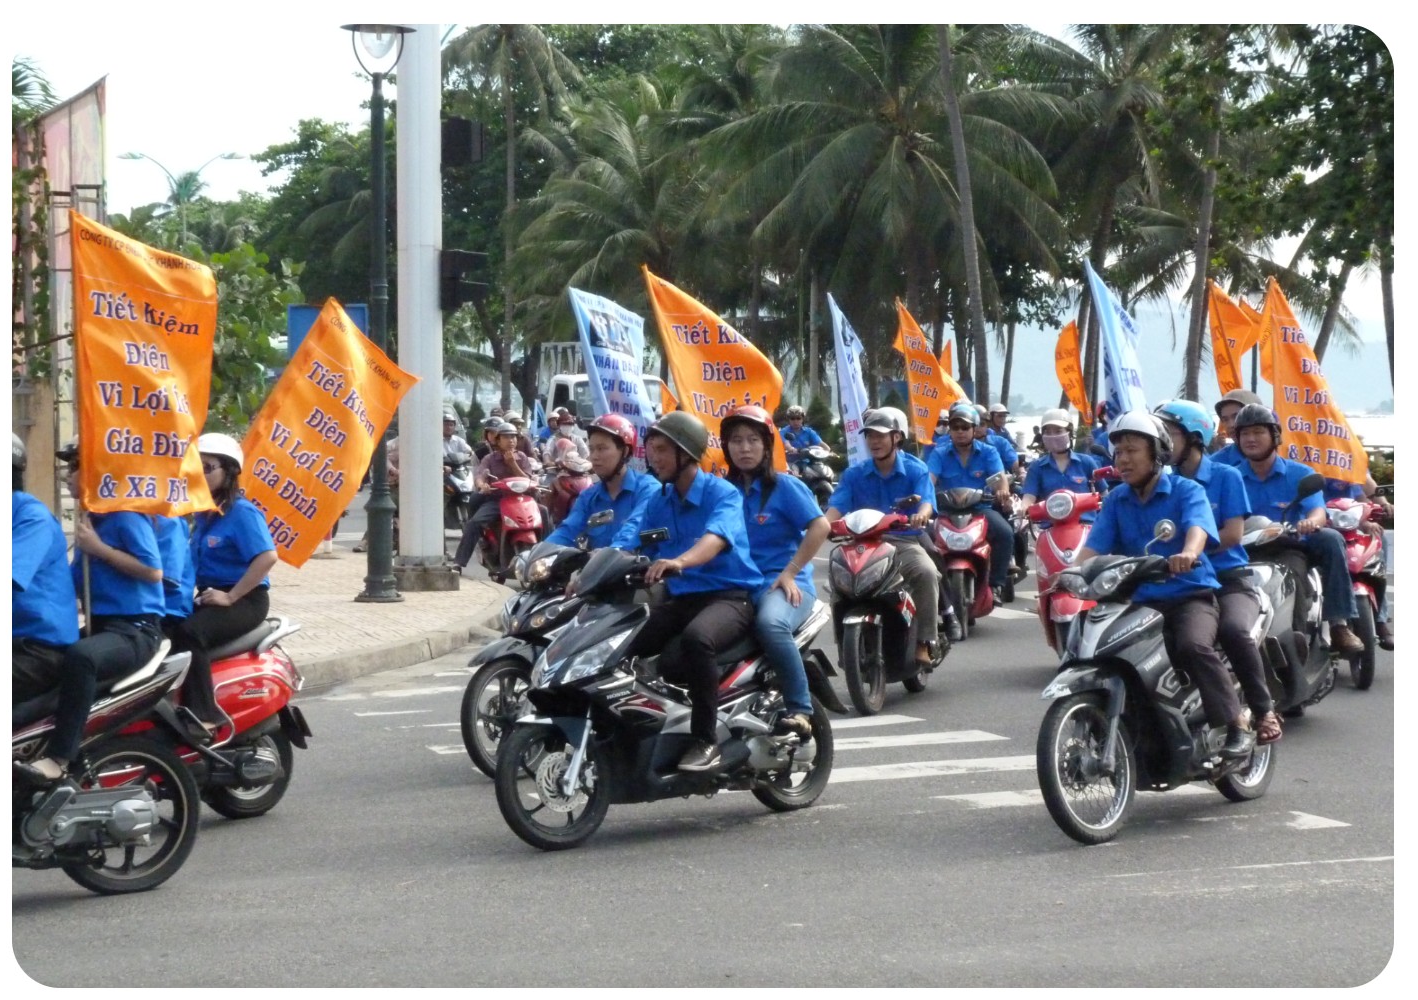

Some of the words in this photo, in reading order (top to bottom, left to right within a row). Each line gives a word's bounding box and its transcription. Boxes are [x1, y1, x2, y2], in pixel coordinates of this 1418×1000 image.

[103, 236, 113, 249] TY
[90, 291, 138, 321] Tiết
[143, 301, 200, 336] Kiệm
[672, 320, 711, 345] Tiết
[124, 341, 170, 373] Điện
[909, 358, 932, 377] Điện
[702, 361, 747, 387] Điện
[98, 381, 123, 407] Vì
[132, 385, 171, 416] Lợi
[307, 360, 345, 399] Tiết
[342, 387, 376, 440] Kiệm
[618, 379, 639, 398] CỰC
[922, 381, 939, 400] Ích
[1284, 386, 1299, 404] Vì
[1304, 388, 1329, 409] Lợi
[622, 402, 640, 417] GIA
[692, 392, 709, 414] Vì
[305, 406, 349, 449] Điện
[1287, 416, 1312, 433] Gia
[106, 428, 144, 455] Gia
[269, 421, 291, 449] Vì
[288, 438, 321, 471] Lợi
[315, 456, 345, 494] Ích
[1288, 445, 1299, 460] &
[1302, 445, 1321, 464] Xã
[1325, 449, 1353, 472] Hội
[98, 475, 118, 499] &
[126, 475, 157, 499] Xã
[252, 457, 281, 489] Gia
[278, 477, 320, 521] Đình
[267, 515, 301, 551] Hội
[1107, 619, 1142, 643] JUPITER
[606, 690, 631, 700] HONDA
